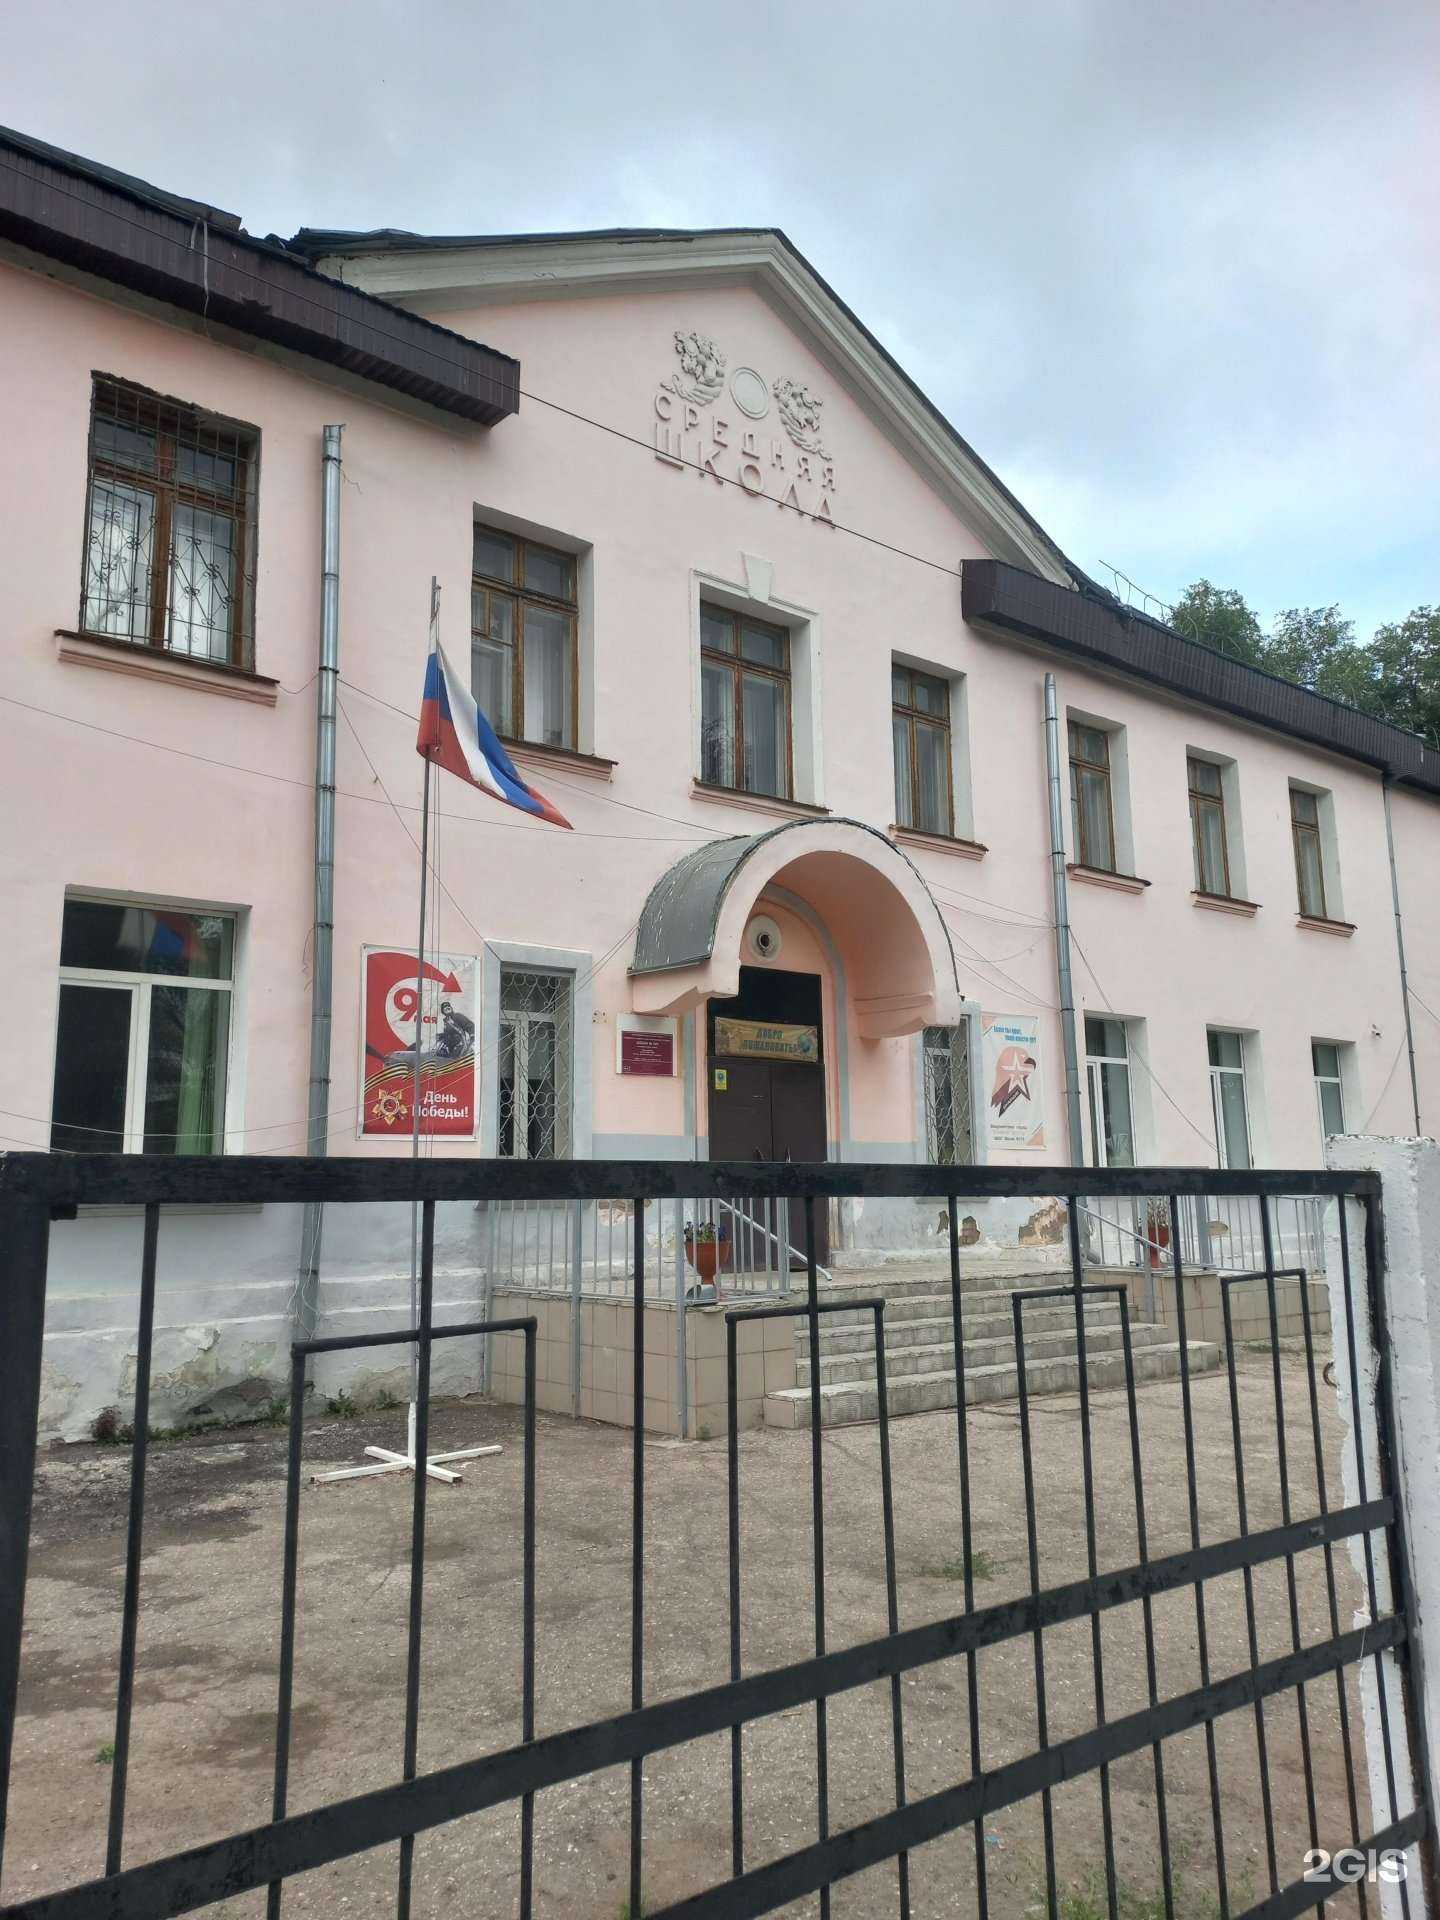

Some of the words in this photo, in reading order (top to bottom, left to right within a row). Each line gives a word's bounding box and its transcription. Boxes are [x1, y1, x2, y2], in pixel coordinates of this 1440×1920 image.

[655, 395, 836, 493] СРЕДНЯЯ
[655, 422, 836, 530] ШКОЛА
[393, 988, 418, 1022] 9
[423, 1090, 457, 1104] День
